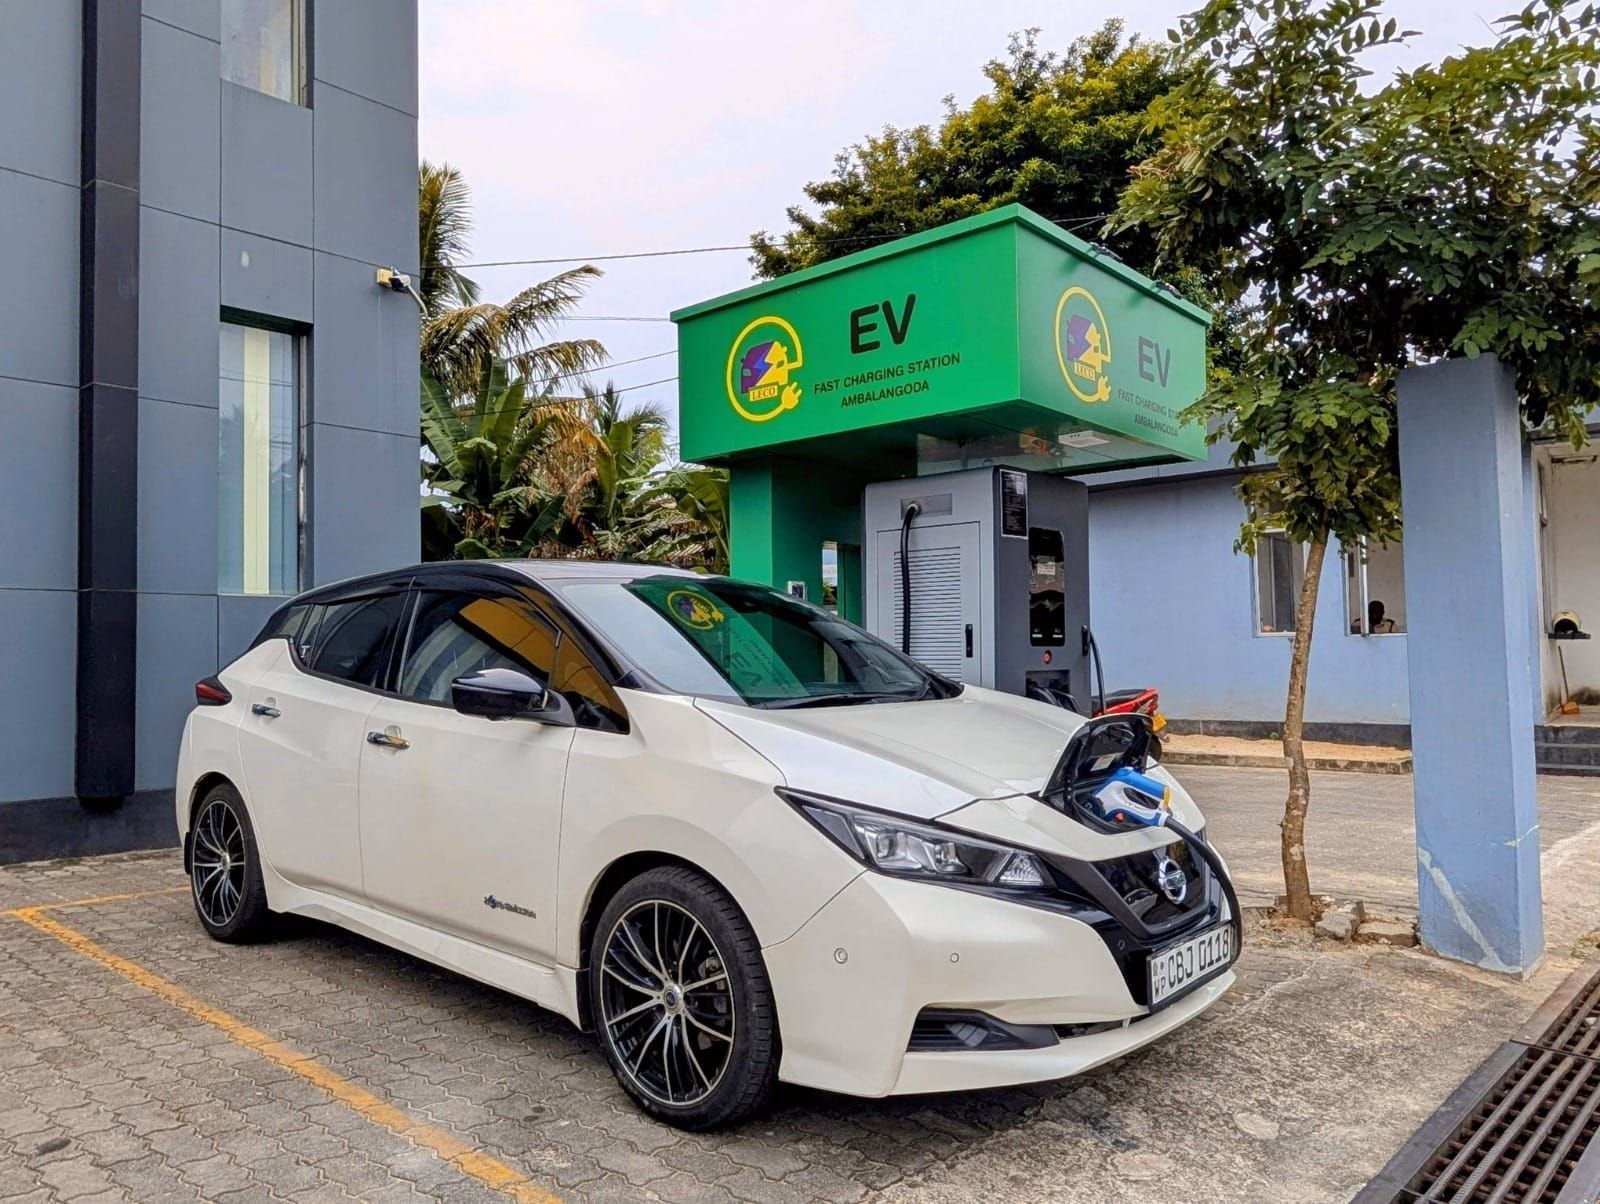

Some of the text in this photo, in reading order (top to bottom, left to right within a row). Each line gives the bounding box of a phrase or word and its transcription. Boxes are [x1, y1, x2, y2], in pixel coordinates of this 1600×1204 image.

[850, 294, 916, 354] EV
[814, 352, 960, 394] FAST CHARGING STATION
[1138, 335, 1171, 388] EV
[752, 386, 776, 400] LECO
[841, 380, 929, 408] AMBALANGODA
[1118, 389, 1134, 403] FAST
[1168, 945, 1193, 988] CBJ
